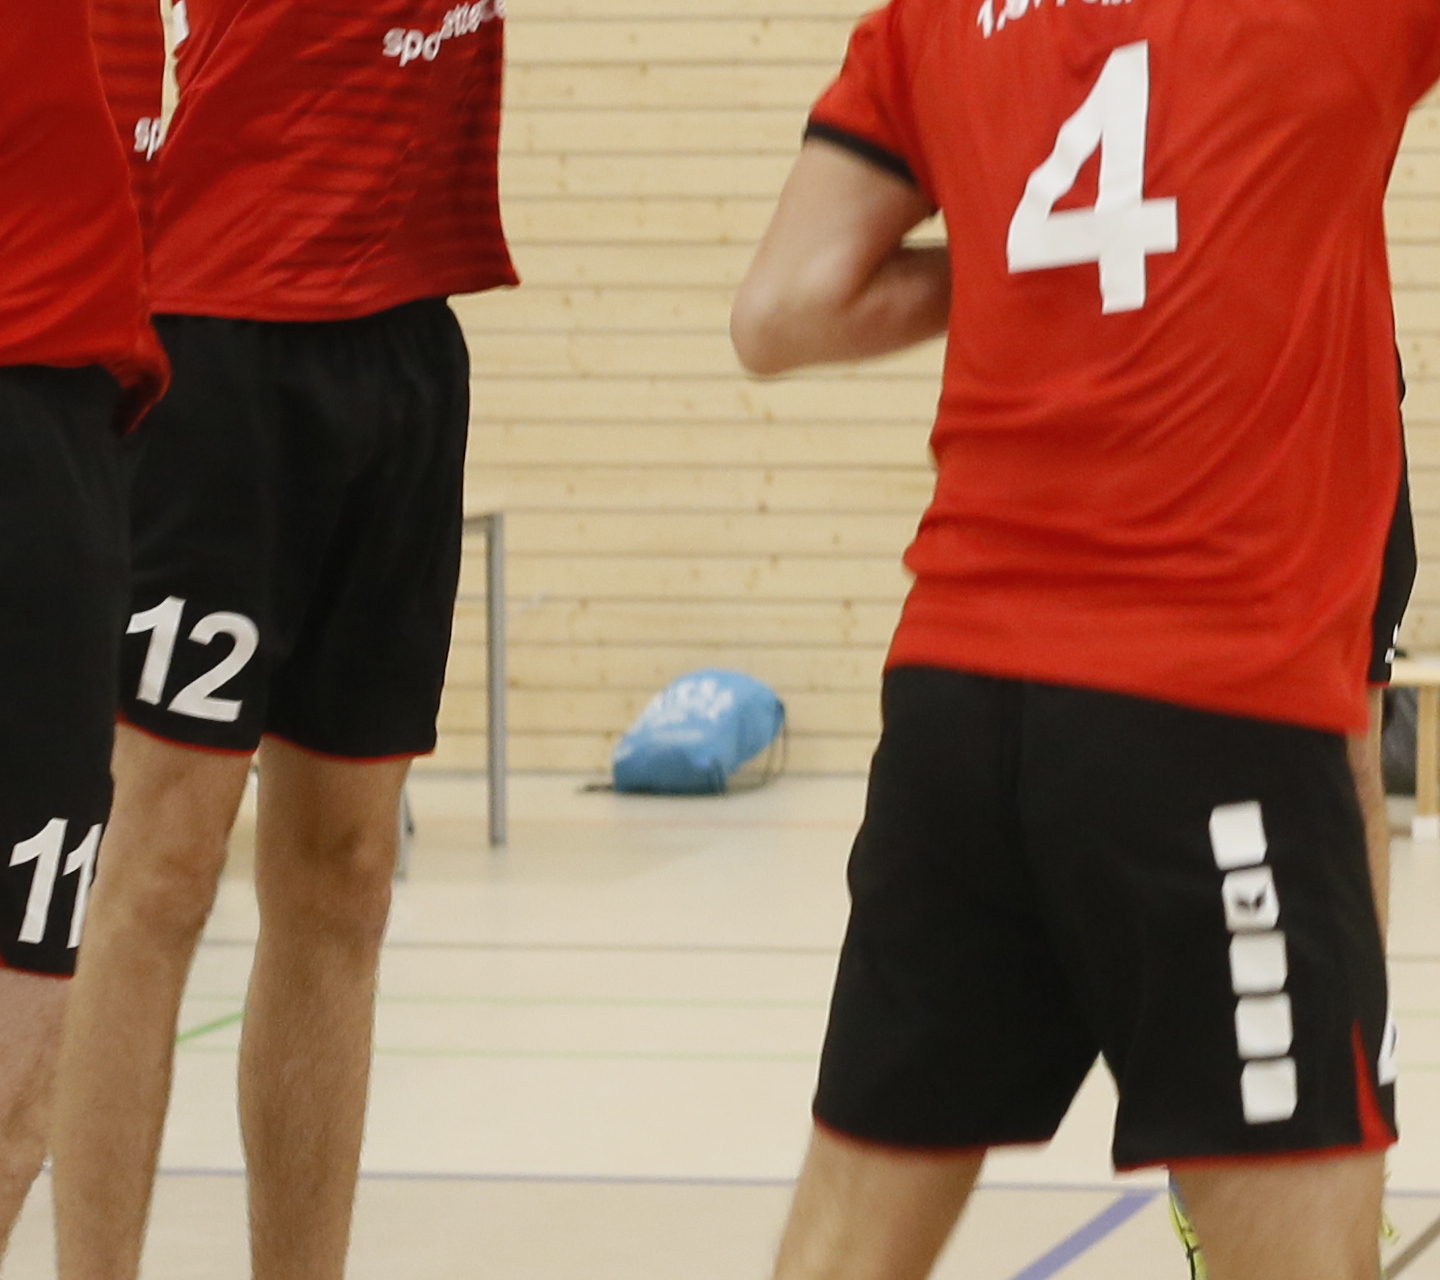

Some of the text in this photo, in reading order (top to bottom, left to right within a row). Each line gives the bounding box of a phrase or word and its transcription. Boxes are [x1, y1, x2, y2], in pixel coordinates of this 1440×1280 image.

[1006, 39, 1178, 315] 4
[124, 595, 261, 722] 12
[8, 816, 103, 949] 11
